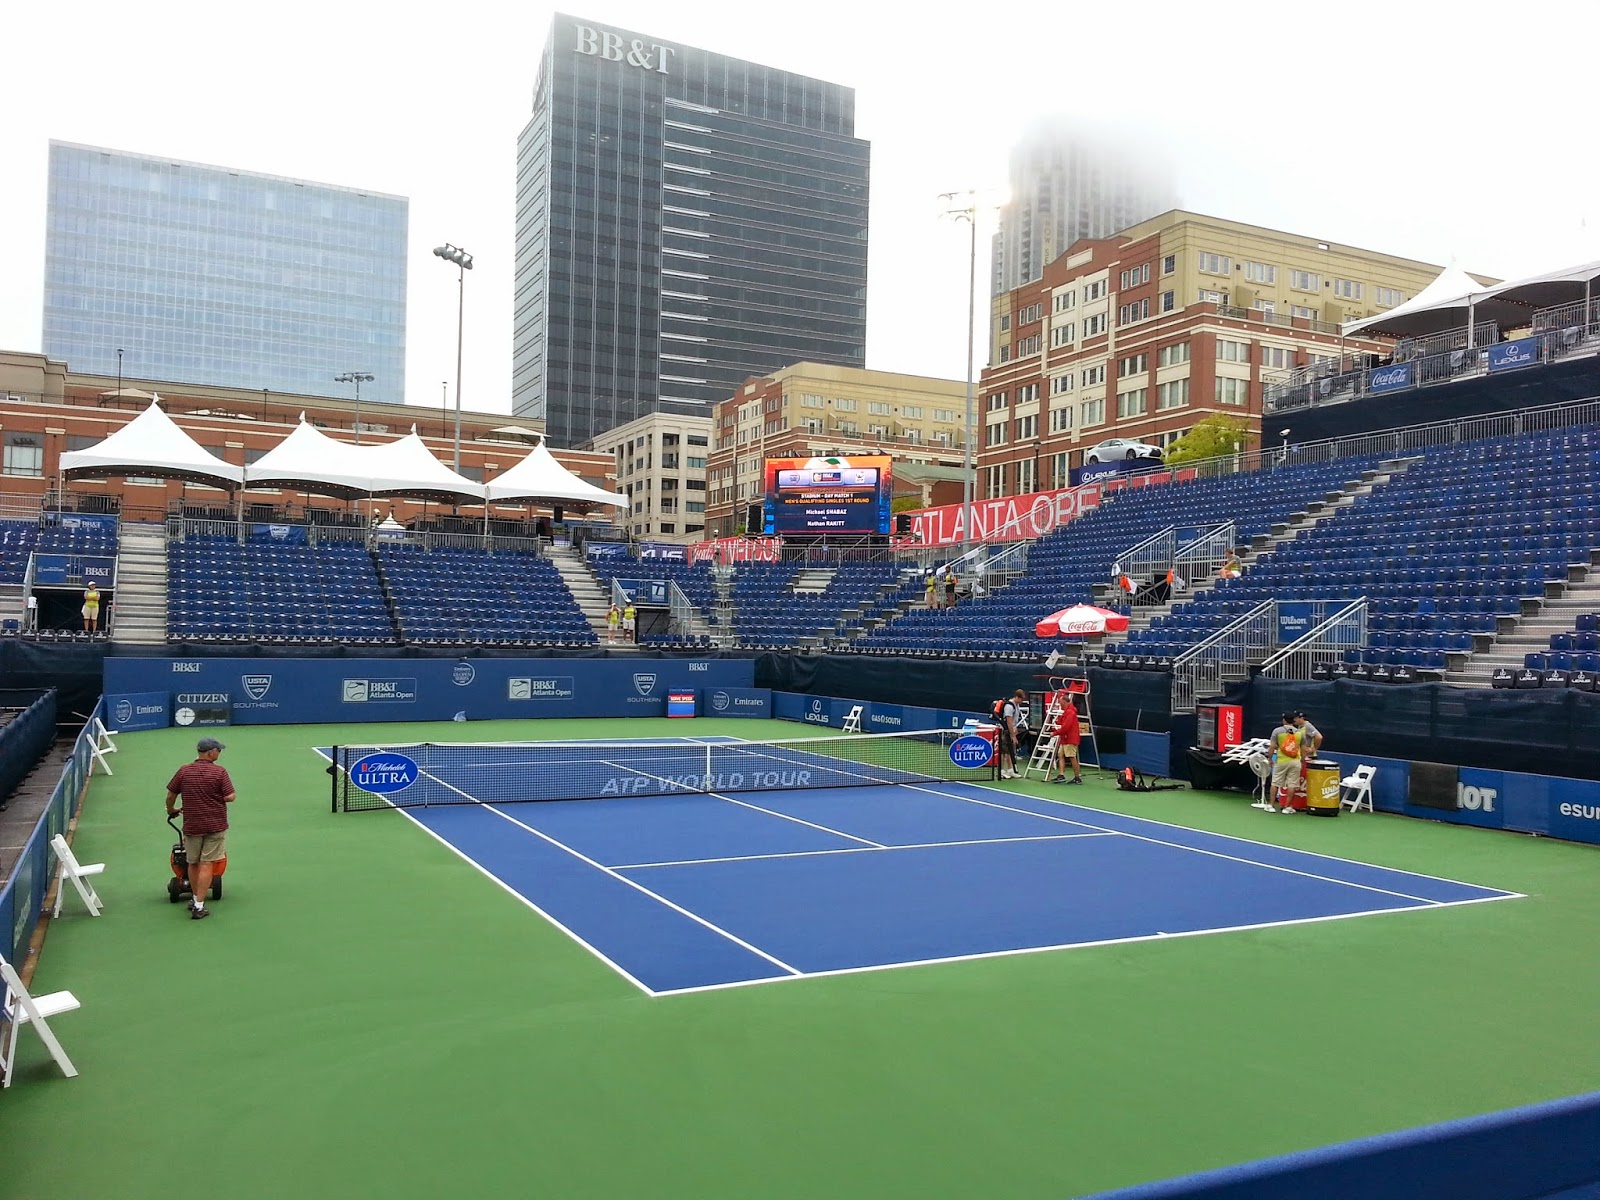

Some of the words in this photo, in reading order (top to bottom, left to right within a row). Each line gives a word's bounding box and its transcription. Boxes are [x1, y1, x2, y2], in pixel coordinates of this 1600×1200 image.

[574, 25, 675, 74] BB&T
[1494, 353, 1531, 366] LEXUS
[1373, 367, 1407, 388] Coca-Cola
[913, 500, 1022, 545] ATLANTA
[1030, 485, 1122, 535] OPE
[85, 567, 111, 576] BB&T
[1280, 616, 1308, 625] Wilson
[1068, 621, 1098, 632] Coca-Cola
[172, 662, 202, 672] BB&T
[688, 663, 710, 671] BB&T
[371, 682, 398, 692] BB&T
[533, 680, 557, 690] BB&T
[556, 689, 571, 697] Open
[177, 693, 229, 704] CITIZEN
[735, 698, 764, 706] Emirates
[136, 705, 163, 714] Emirates
[804, 713, 829, 723] LEXUS
[871, 714, 881, 722] GAS
[885, 716, 900, 725] SOUTH
[1226, 710, 1235, 741] Coca-Cola
[954, 751, 988, 761] ULTRA
[368, 762, 407, 772] Michelob
[358, 771, 411, 784] ULTRA
[600, 777, 649, 794] ATP
[659, 773, 744, 792] WORLD
[752, 770, 811, 787] TOUR
